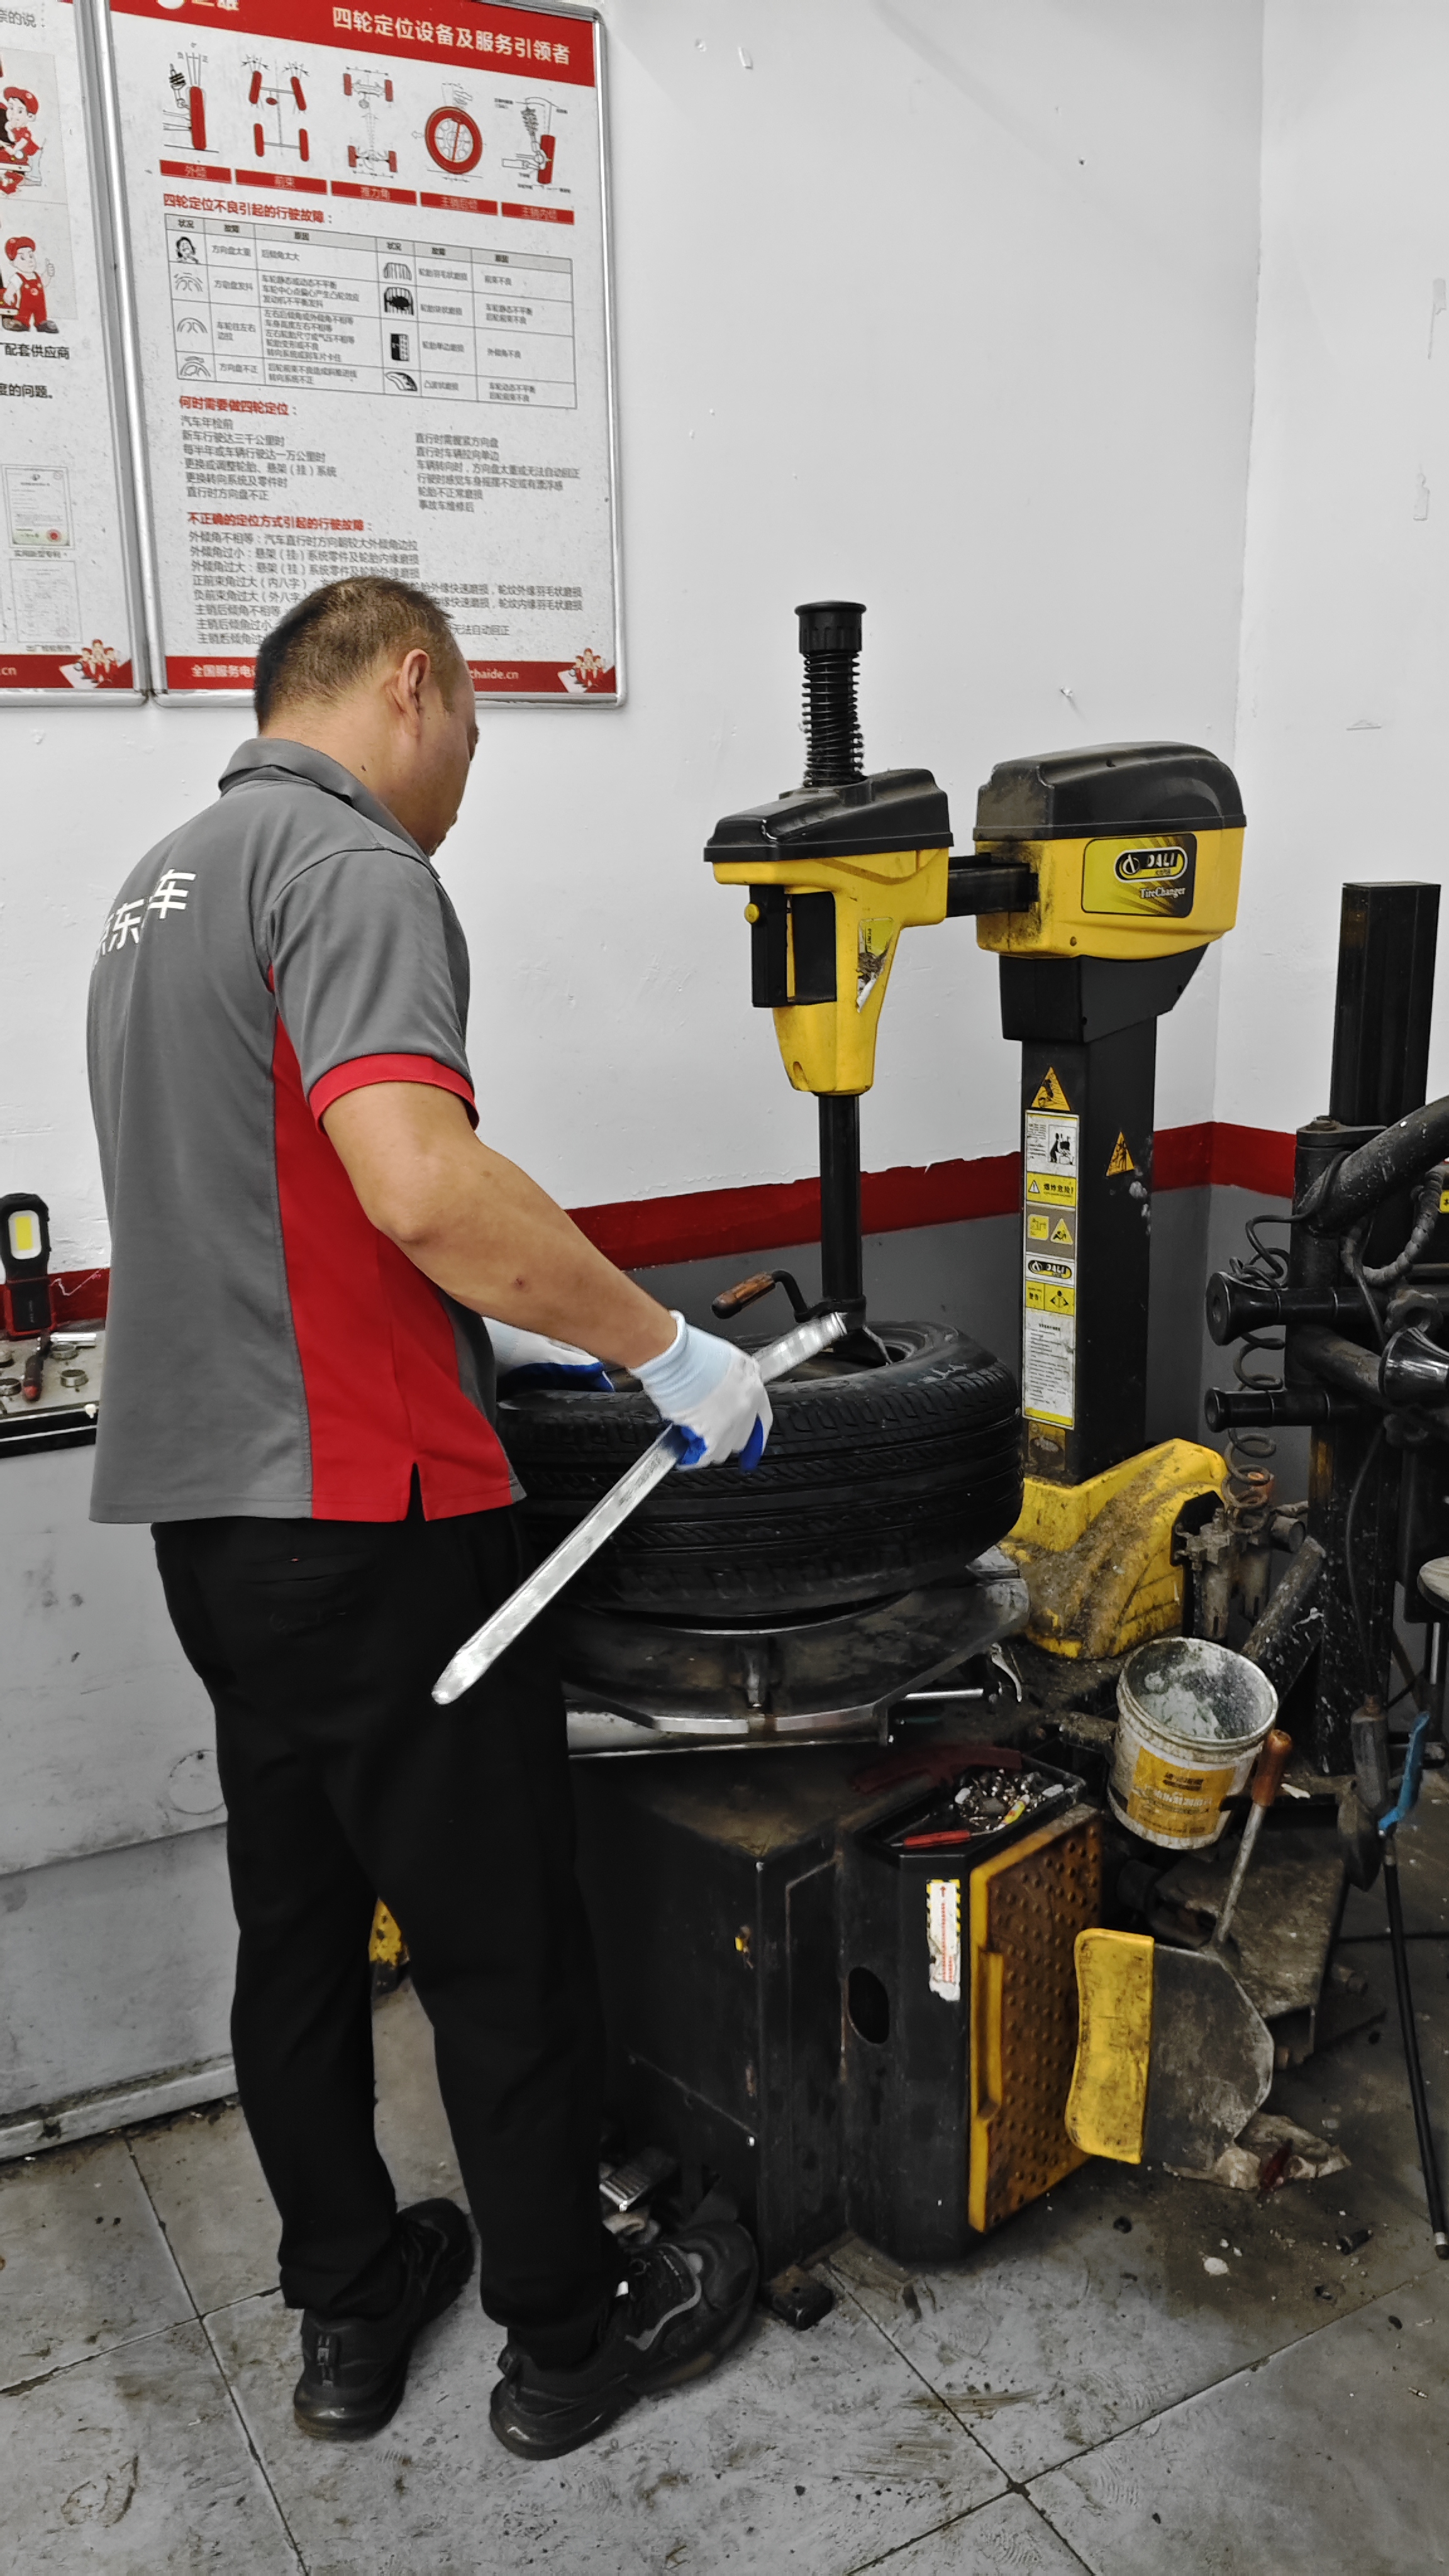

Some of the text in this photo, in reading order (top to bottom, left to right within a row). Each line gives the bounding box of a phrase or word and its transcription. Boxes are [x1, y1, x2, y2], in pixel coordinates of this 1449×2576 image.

[333, 7, 570, 65] 四轮定位设备及服务引领者
[0, 342, 70, 360] 配套供应商
[1147, 853, 1175, 867] DALI
